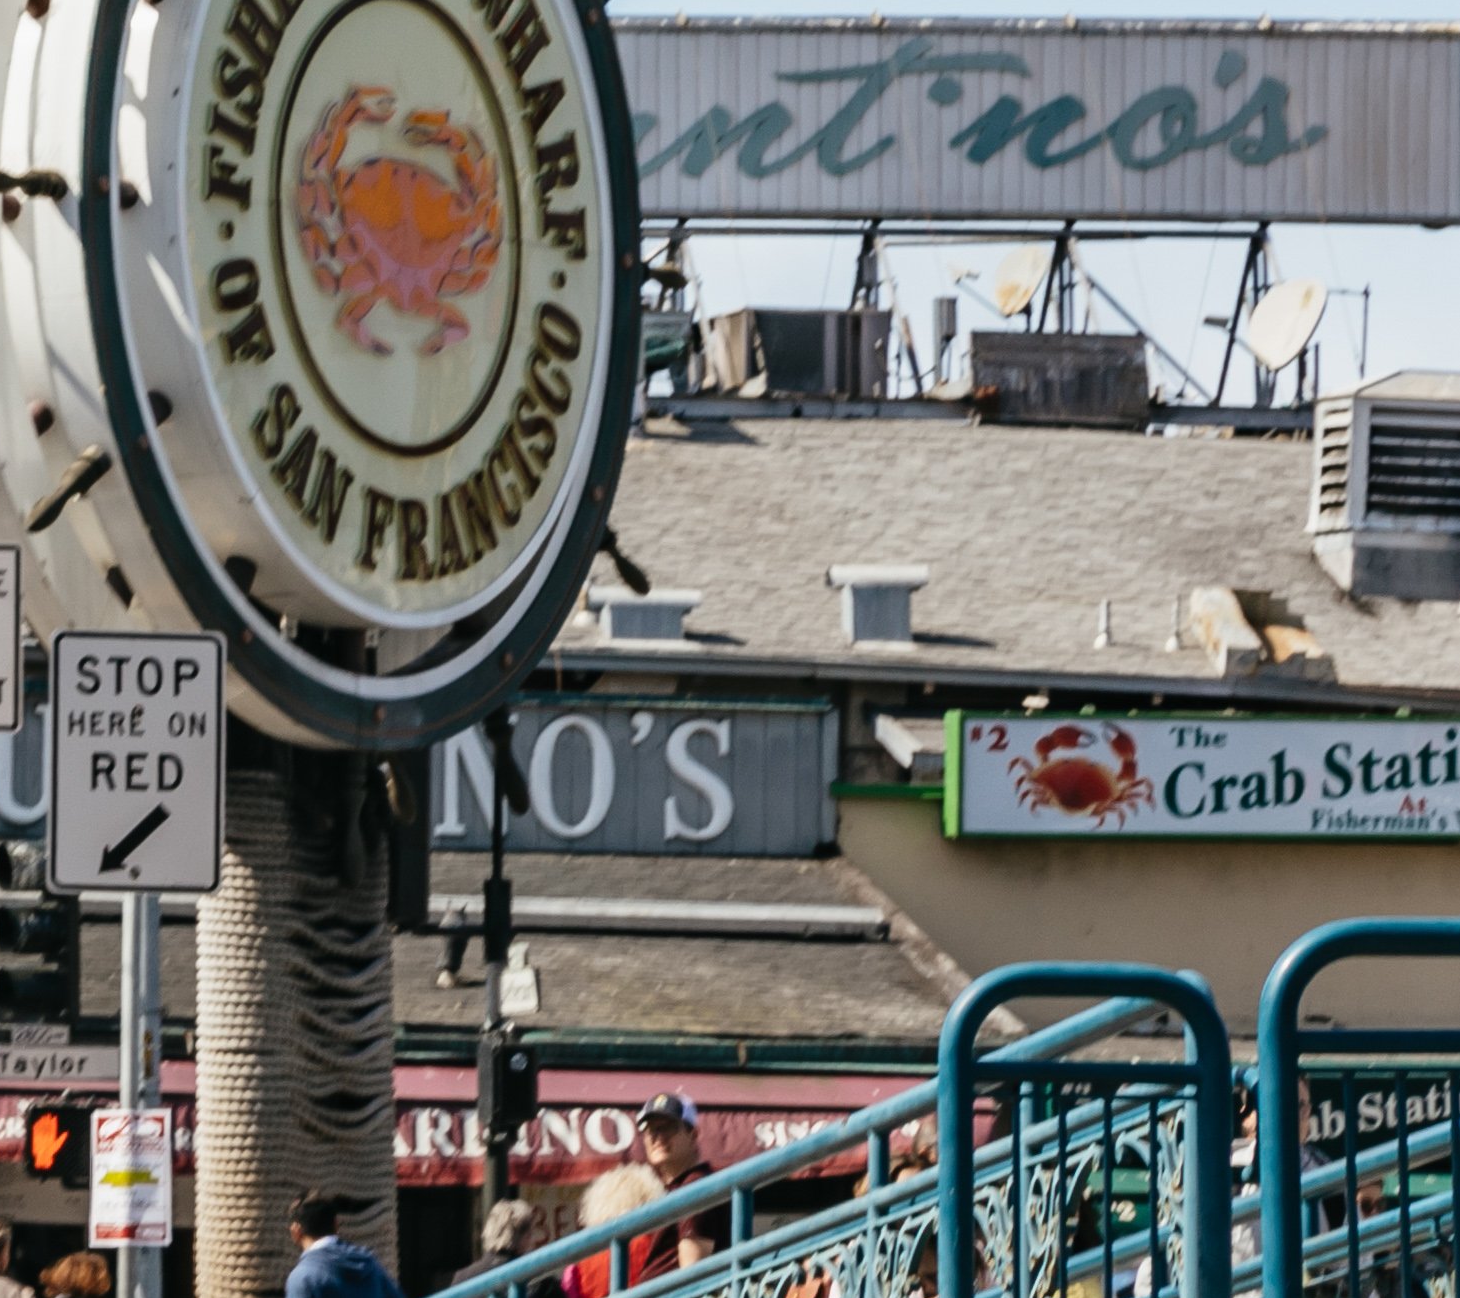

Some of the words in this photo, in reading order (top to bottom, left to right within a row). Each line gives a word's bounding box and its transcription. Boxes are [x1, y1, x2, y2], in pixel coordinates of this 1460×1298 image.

[211, 257, 277, 367] OF
[249, 382, 355, 544] SAN
[355, 302, 585, 582] FRANCISCO
[75, 655, 201, 698] STOP
[67, 710, 145, 739] HERE
[167, 711, 207, 739] ON
[971, 724, 1010, 753] #2
[1169, 725, 1228, 749] The
[89, 750, 185, 793] RED
[1163, 748, 1306, 820] Crab
[1310, 806, 1449, 832] Fisherman's
[1397, 794, 1427, 816] At
